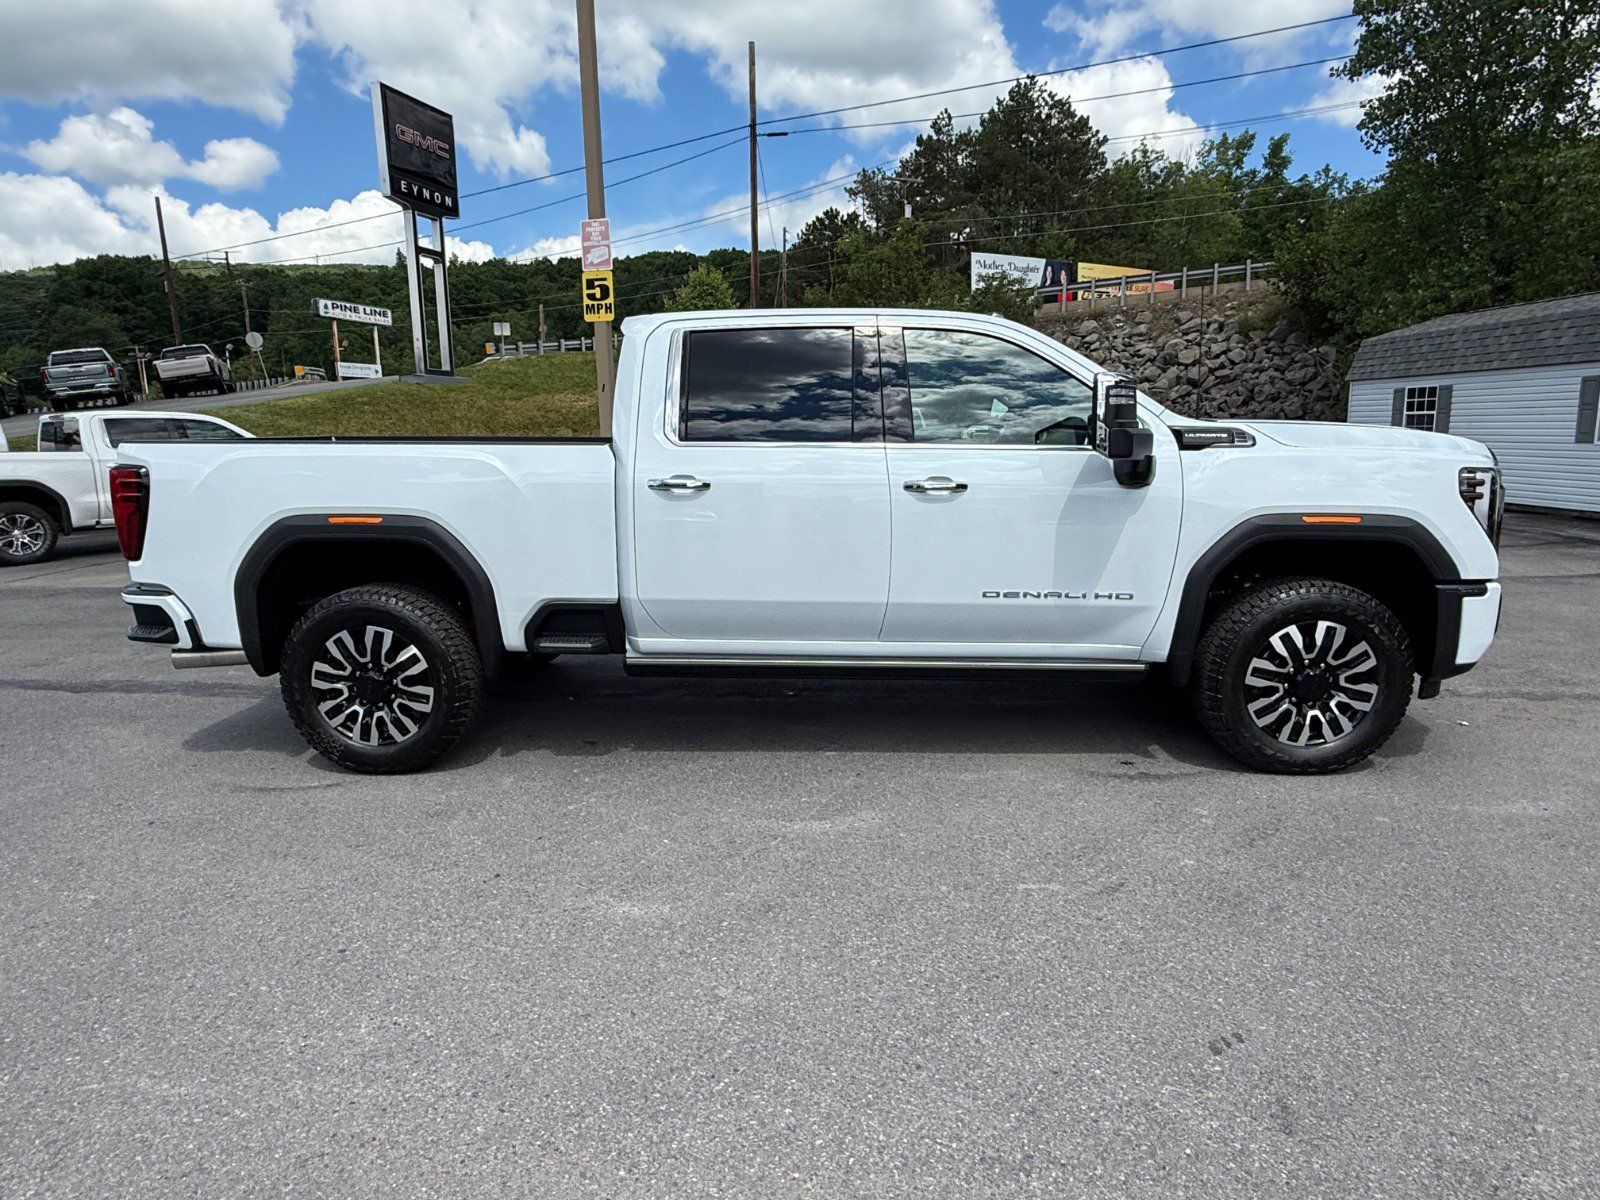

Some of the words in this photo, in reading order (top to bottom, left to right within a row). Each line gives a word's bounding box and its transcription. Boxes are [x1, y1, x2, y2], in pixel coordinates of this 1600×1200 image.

[395, 124, 449, 159] GMC
[401, 180, 452, 207] EYNON
[586, 278, 610, 301] 5
[332, 303, 360, 314] PINE
[363, 307, 389, 318] LINE
[586, 303, 612, 315] MPH
[982, 591, 1087, 599] DENALI
[1094, 592, 1134, 600] HD
